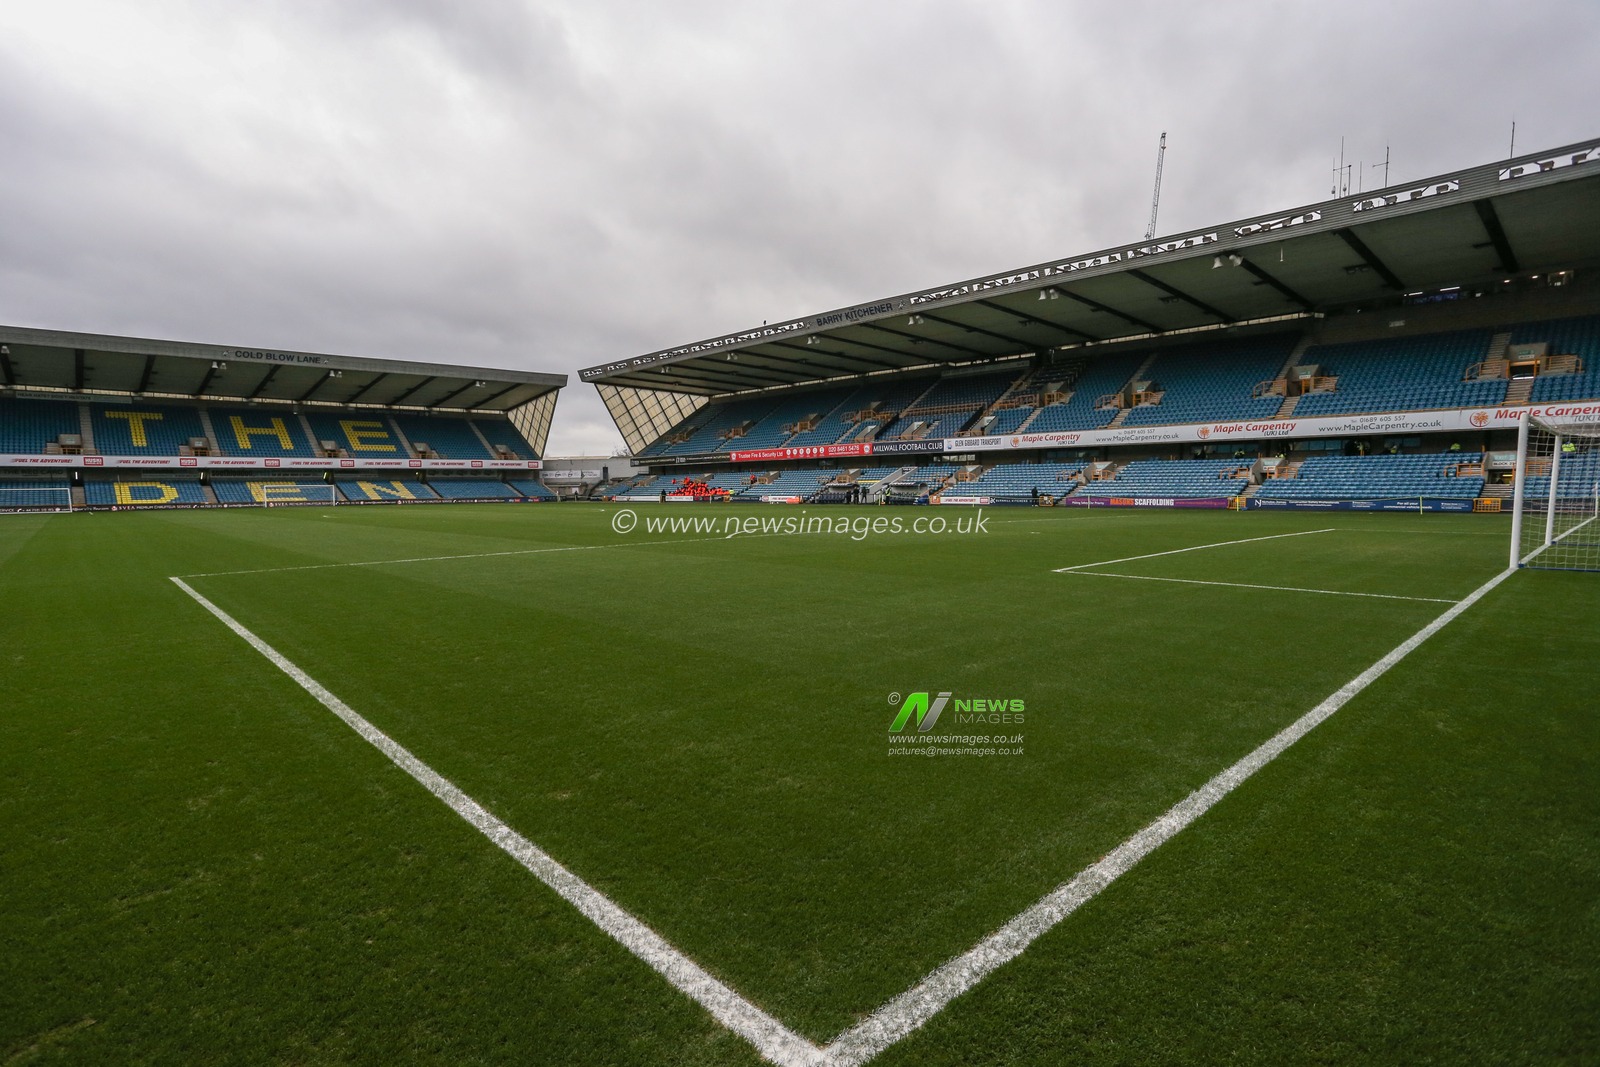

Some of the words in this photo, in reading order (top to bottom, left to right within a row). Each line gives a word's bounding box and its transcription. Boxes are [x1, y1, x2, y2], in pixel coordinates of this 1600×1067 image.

[816, 313, 844, 326] BARRY
[845, 303, 893, 320] KITCHENER
[235, 350, 263, 360] COLD
[266, 352, 294, 362] BLOW
[297, 354, 321, 364] LANE
[104, 410, 397, 452] THE
[1213, 424, 1243, 434] Maple
[1246, 422, 1297, 433] Carpentry
[1318, 420, 1442, 432] www.MapleCarpentry.co.uk
[981, 438, 1002, 446] TRANSPORT
[1022, 436, 1044, 444] Maple
[1044, 434, 1081, 442] Carpentry
[1096, 433, 1180, 442] www.MapleCarpentry.co.uk
[873, 444, 898, 452] MILLWALL
[899, 443, 927, 451] FOOTBALL
[928, 442, 943, 450] CLUB
[113, 480, 417, 504] DEN
